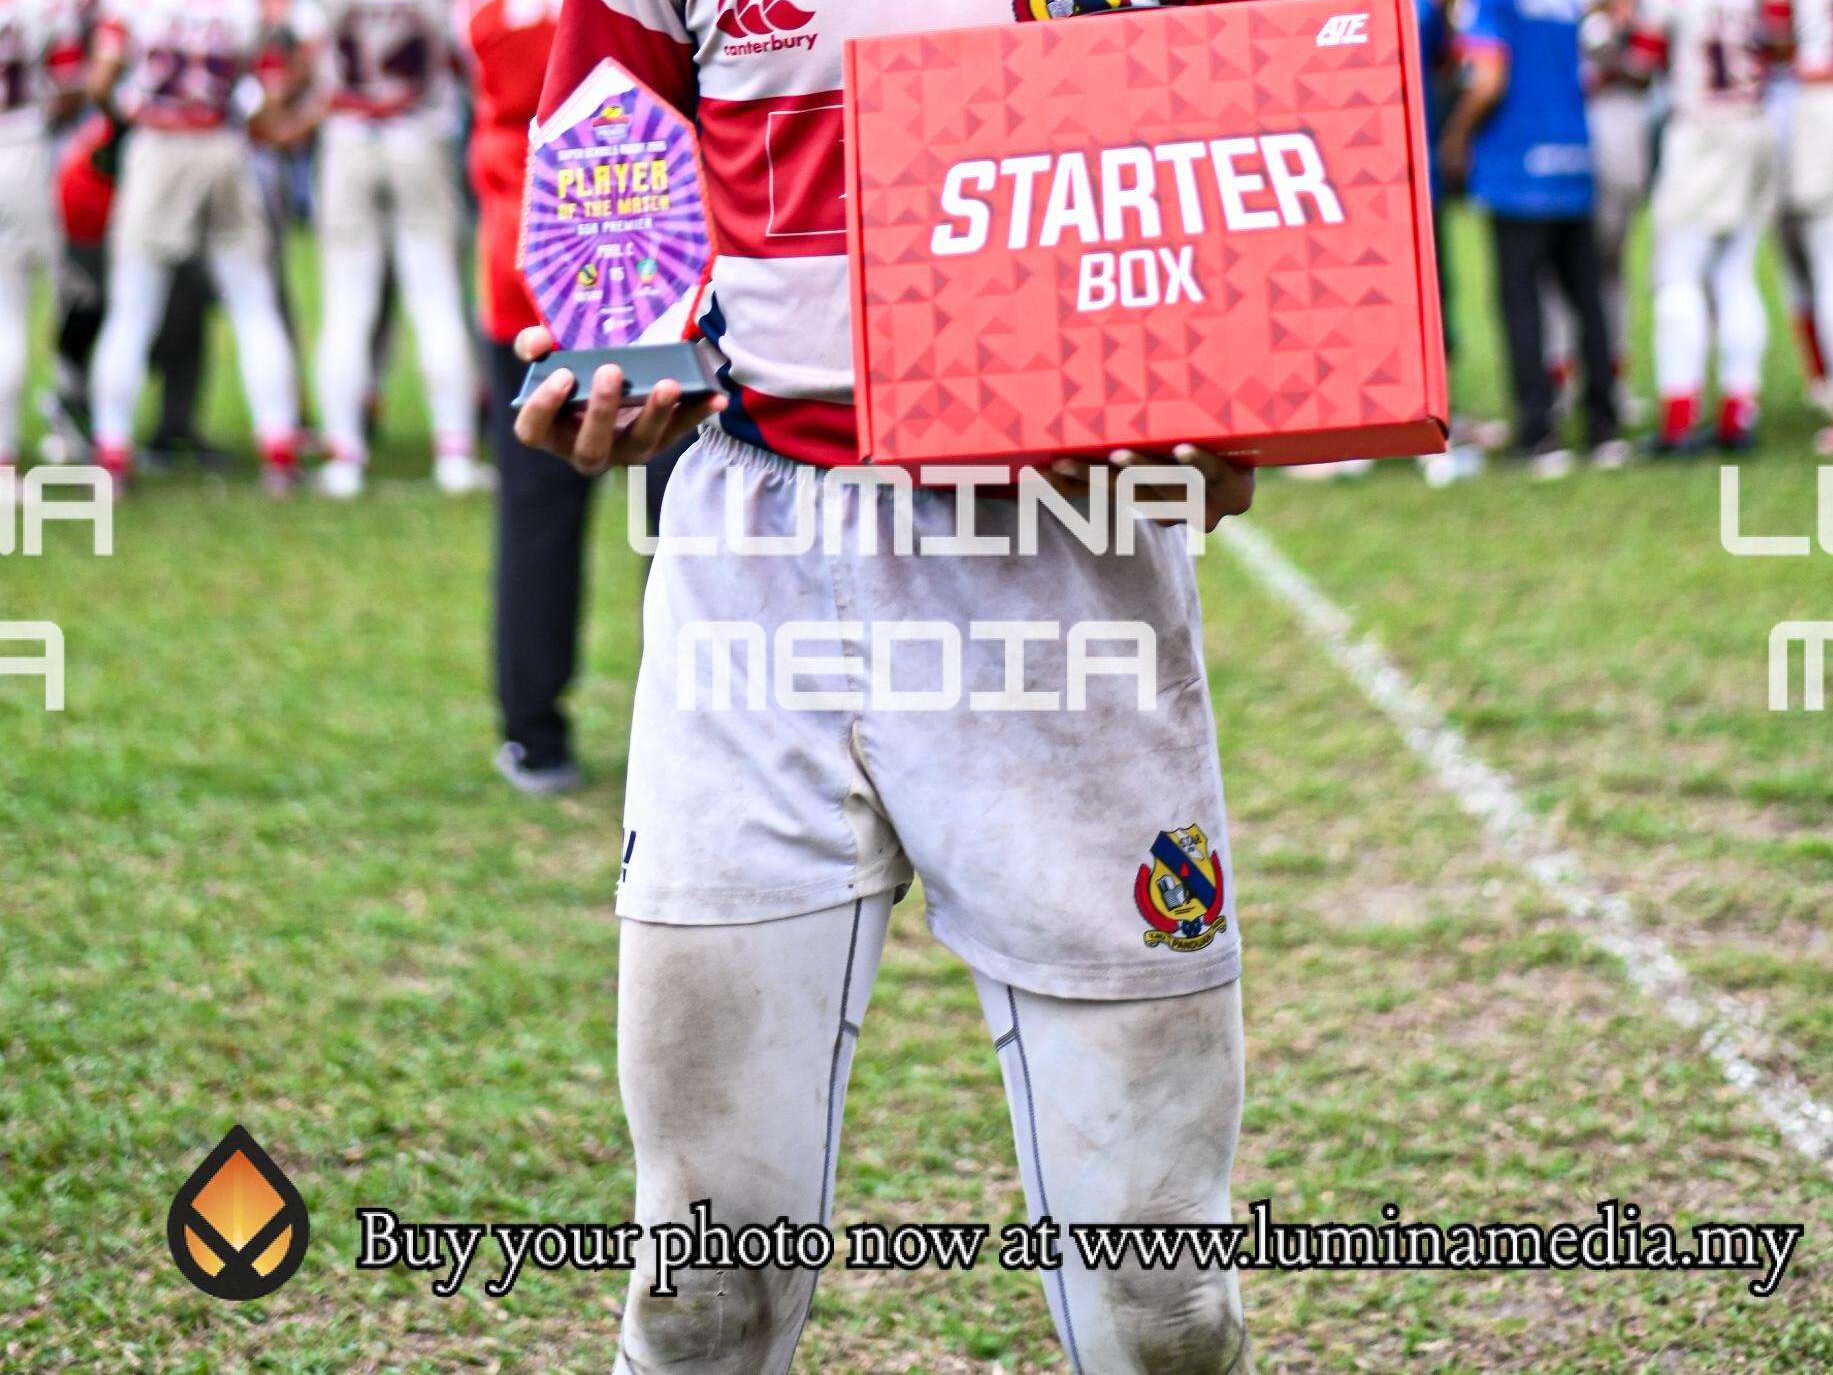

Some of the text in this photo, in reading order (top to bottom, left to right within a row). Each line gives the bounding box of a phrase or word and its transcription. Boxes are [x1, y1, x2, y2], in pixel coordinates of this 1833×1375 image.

[724, 33, 818, 56] canterbury
[558, 159, 668, 199] PLAYER
[931, 132, 1346, 257] STARTER
[558, 194, 670, 221] OF THE MATCH
[602, 217, 652, 233] PREMIER
[1076, 244, 1204, 313] BOX
